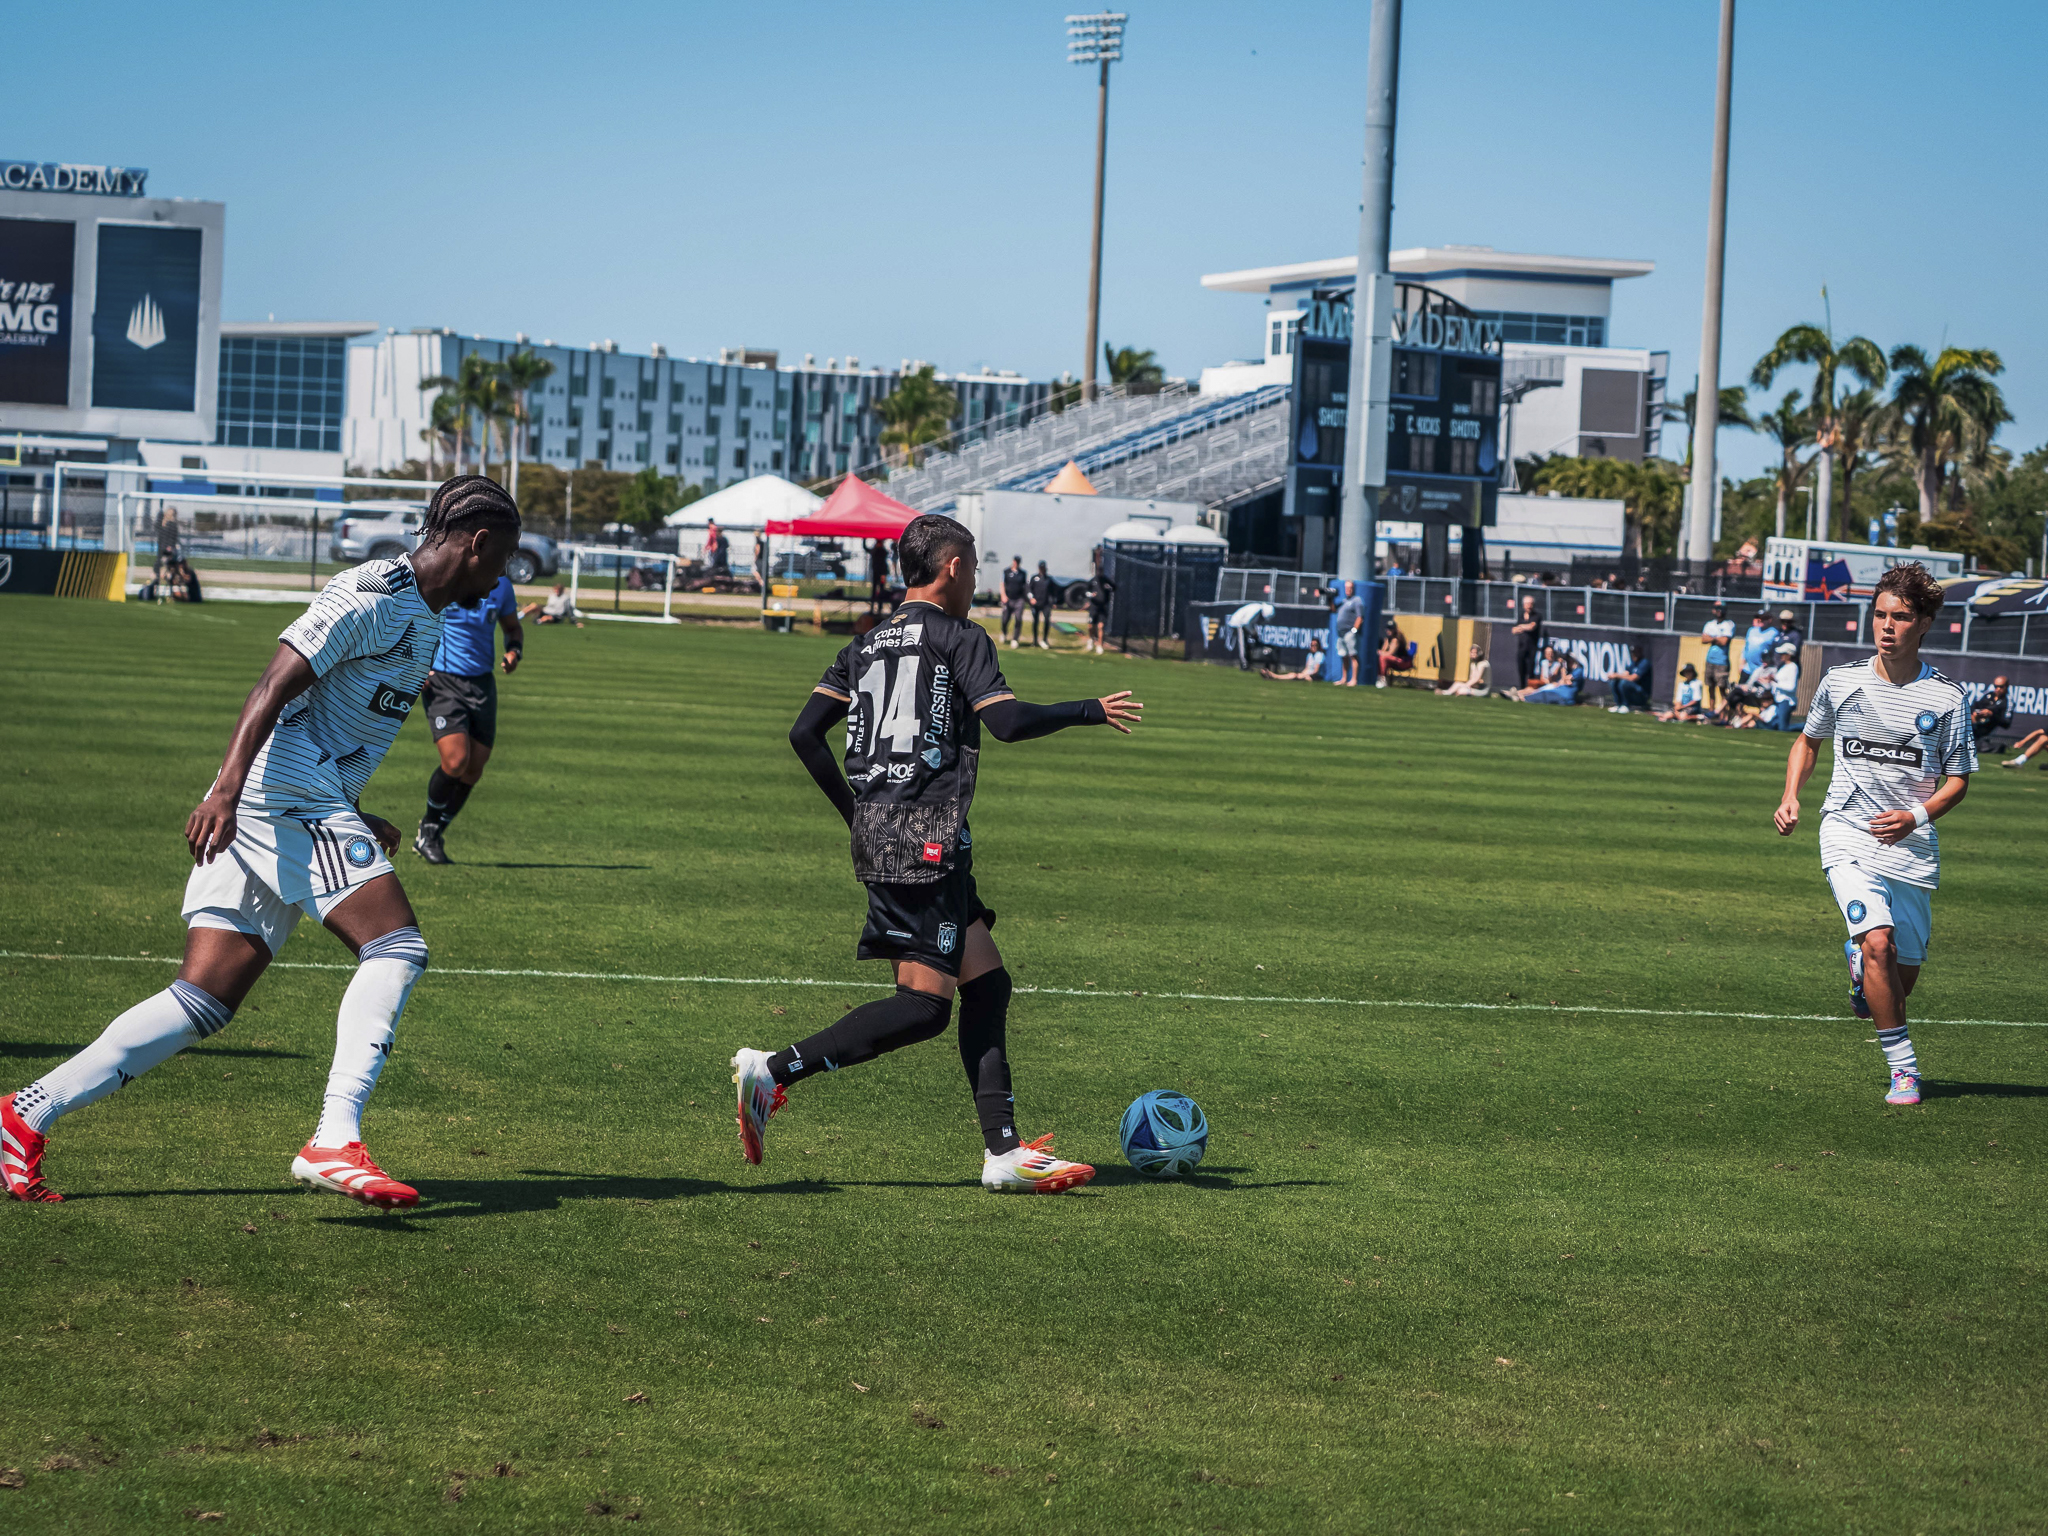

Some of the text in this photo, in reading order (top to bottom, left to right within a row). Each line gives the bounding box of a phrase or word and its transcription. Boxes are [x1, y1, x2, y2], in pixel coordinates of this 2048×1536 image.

[1307, 300, 1353, 338] IM
[1318, 406, 1348, 427] SHOT
[858, 655, 921, 758] 14
[854, 726, 864, 753] STYLE
[1862, 746, 1917, 762] LEXUS
[887, 762, 916, 778] KOE
